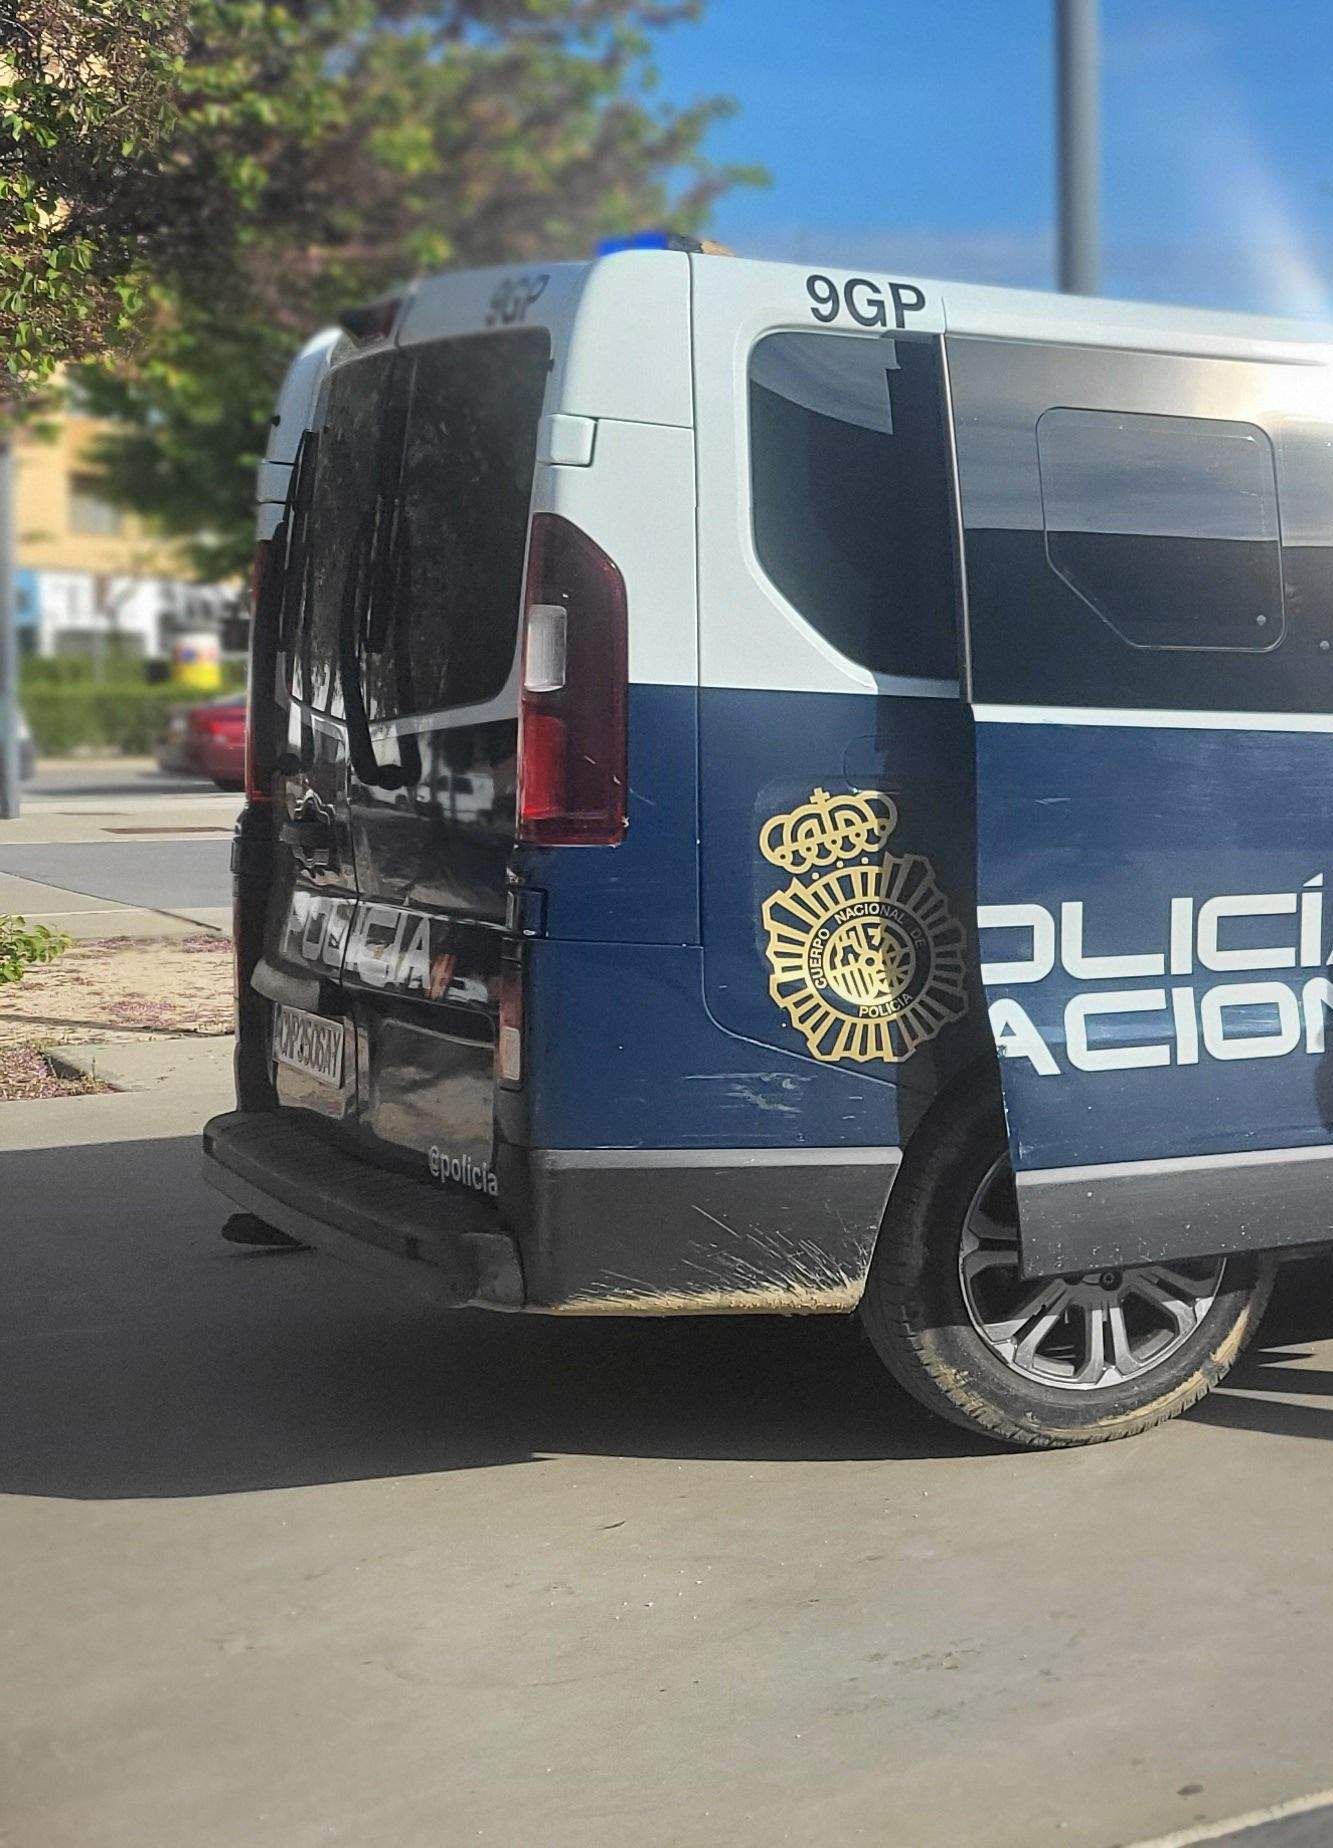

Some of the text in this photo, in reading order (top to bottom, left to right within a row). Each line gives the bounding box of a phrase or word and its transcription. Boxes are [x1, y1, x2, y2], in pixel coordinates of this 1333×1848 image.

[806, 274, 926, 329] 9GP
[809, 903, 927, 990] CUERPO NACIONAL DE
[857, 992, 914, 1018] POLICIA
